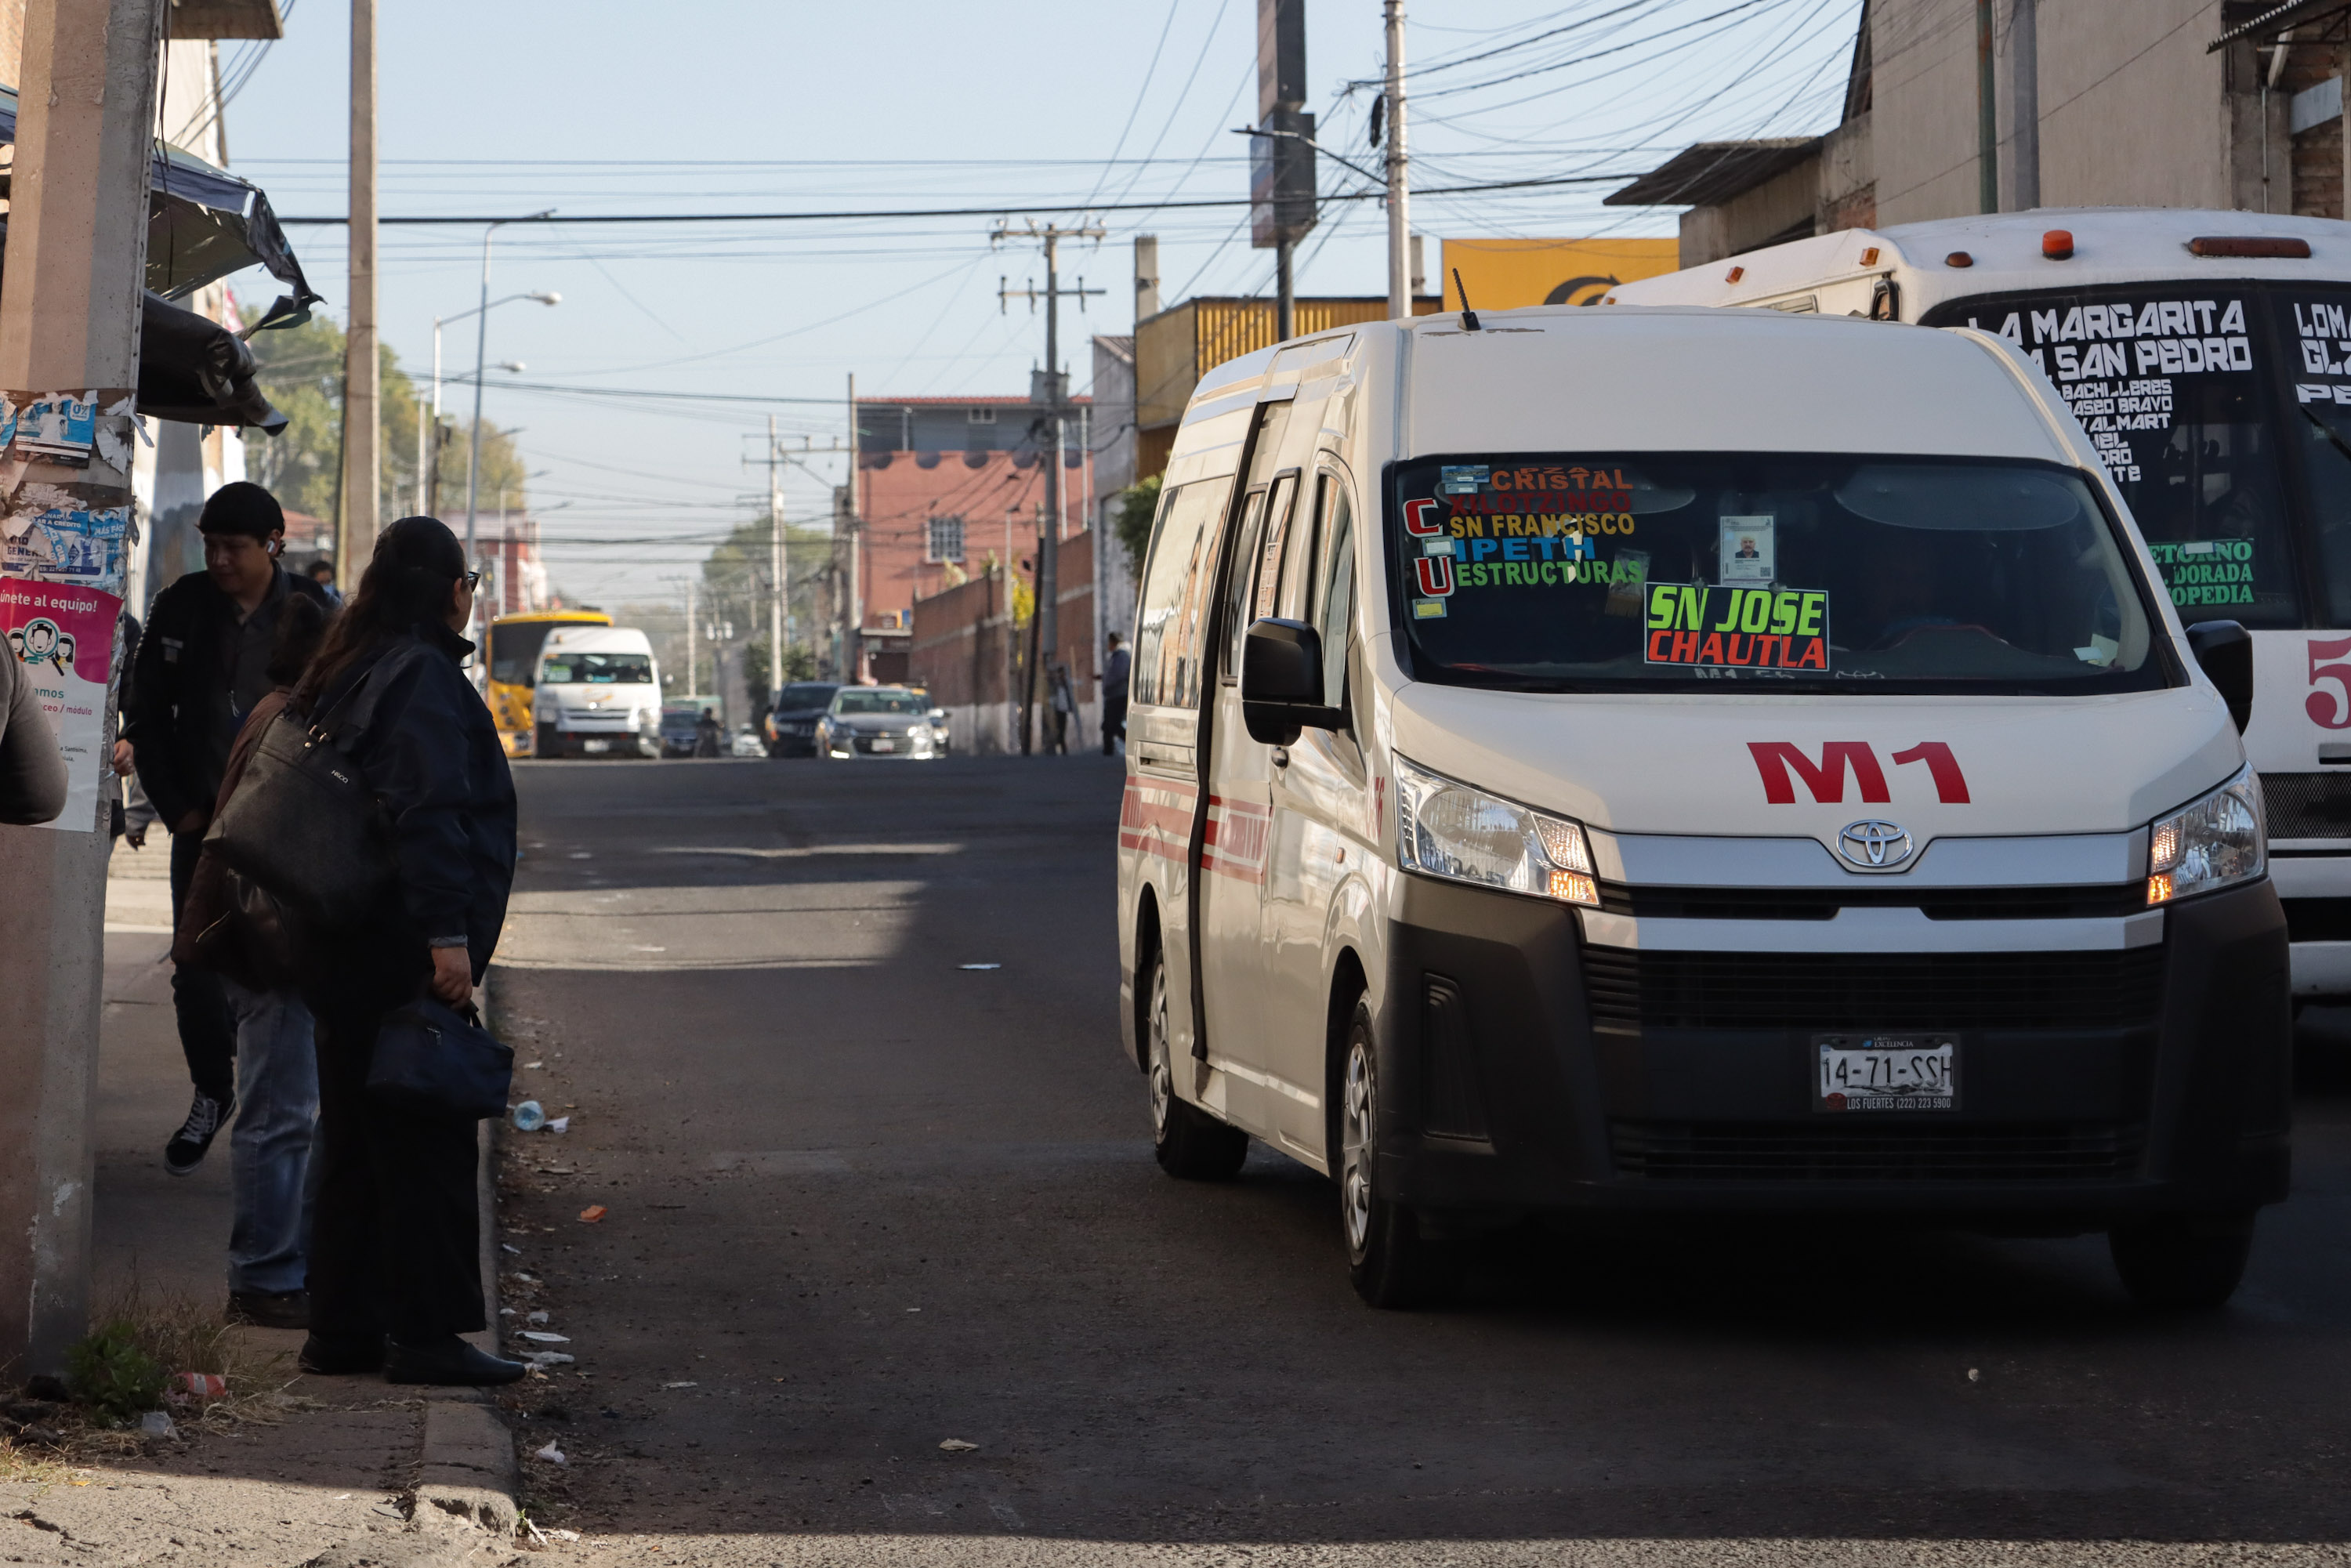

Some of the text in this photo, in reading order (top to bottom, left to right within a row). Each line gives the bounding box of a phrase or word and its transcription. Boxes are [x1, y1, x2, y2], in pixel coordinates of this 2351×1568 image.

[2030, 300, 2246, 344] MARGARITA
[2294, 303, 2351, 339] LOM
[2055, 342, 2128, 381] SAN
[2135, 337, 2253, 375] PEDRO
[2118, 396, 2172, 413] BRAVO
[1491, 469, 1633, 491] CRISTAL
[1448, 491, 1632, 516] XILOTZINGO
[1450, 513, 1635, 538] SN FRANCISCO
[1454, 537, 1596, 562] IPETH
[1456, 560, 1644, 587] ESTRUCTURAS
[34, 595, 47, 607] al
[51, 598, 98, 614] equipo!
[2168, 585, 2255, 606] OPEDIA
[1647, 585, 1825, 636] SN JOSE
[1647, 630, 1826, 669] CHAUTLA
[1747, 741, 1971, 804] M1
[1847, 1098, 1951, 1110] LOS FUERTES (222) 223 5900
